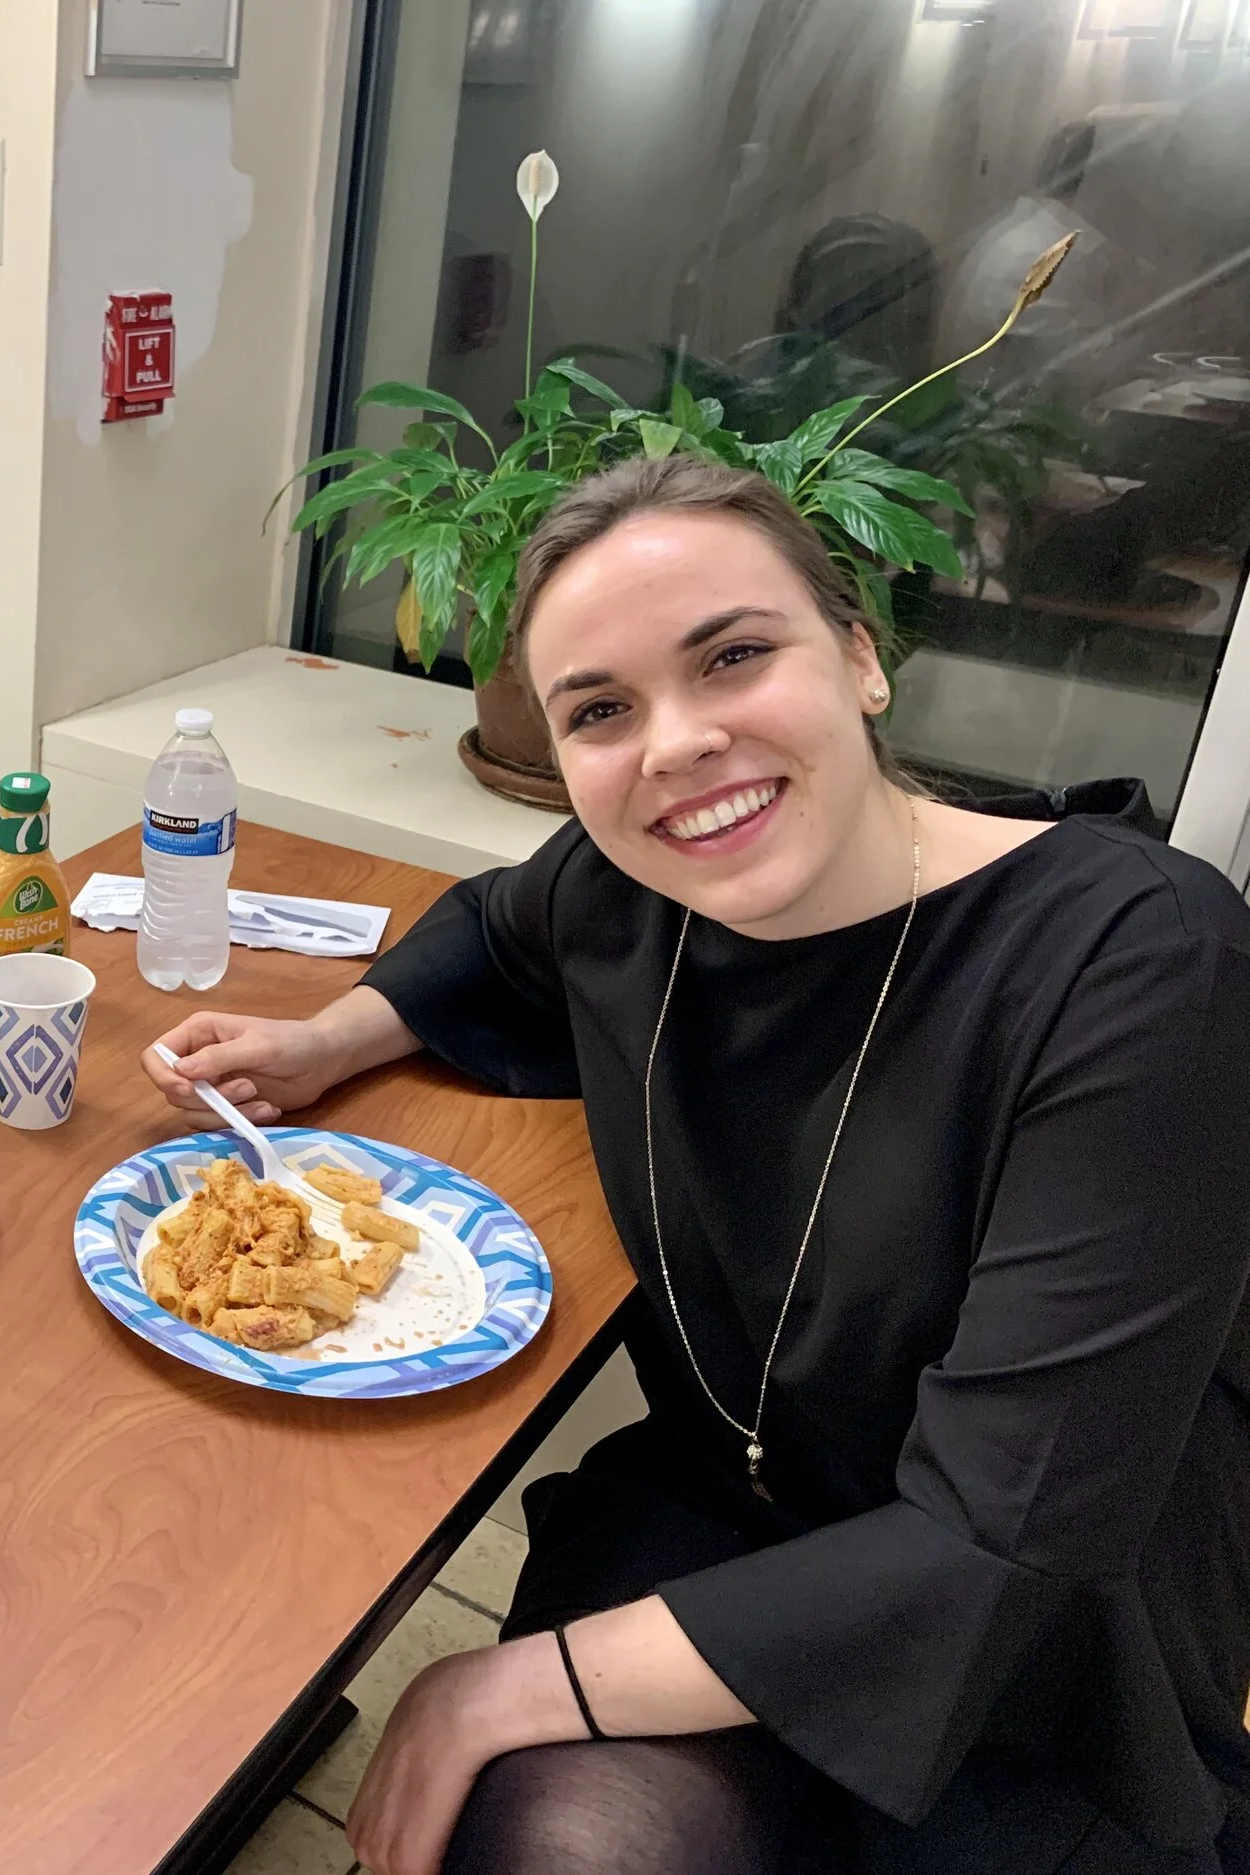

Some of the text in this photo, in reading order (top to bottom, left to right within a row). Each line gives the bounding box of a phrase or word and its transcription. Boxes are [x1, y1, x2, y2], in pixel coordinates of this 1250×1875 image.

[138, 337, 161, 350] LIFT
[145, 354, 154, 366] &
[136, 370, 162, 384] PULL
[151, 813, 197, 829] KIRKLAND
